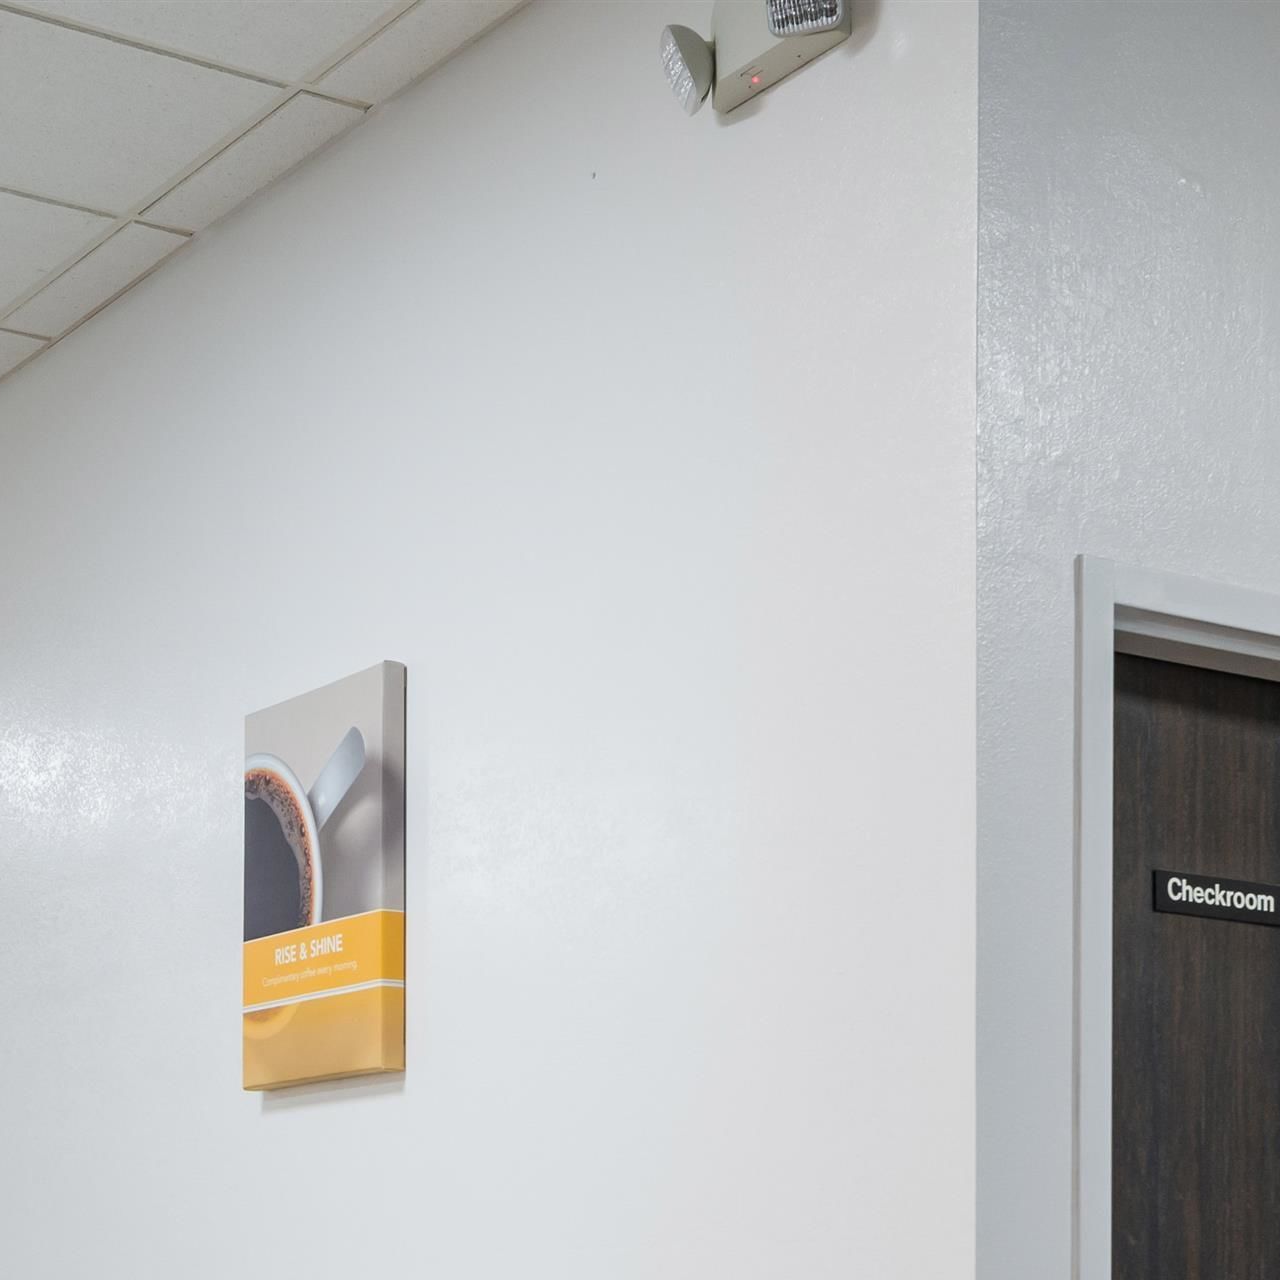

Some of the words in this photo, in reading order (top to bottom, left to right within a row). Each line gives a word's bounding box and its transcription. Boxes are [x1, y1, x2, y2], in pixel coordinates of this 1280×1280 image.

[1167, 877, 1275, 912] Checkroom
[274, 944, 297, 966] RISE
[300, 942, 308, 960] &
[310, 934, 344, 958] SHINE
